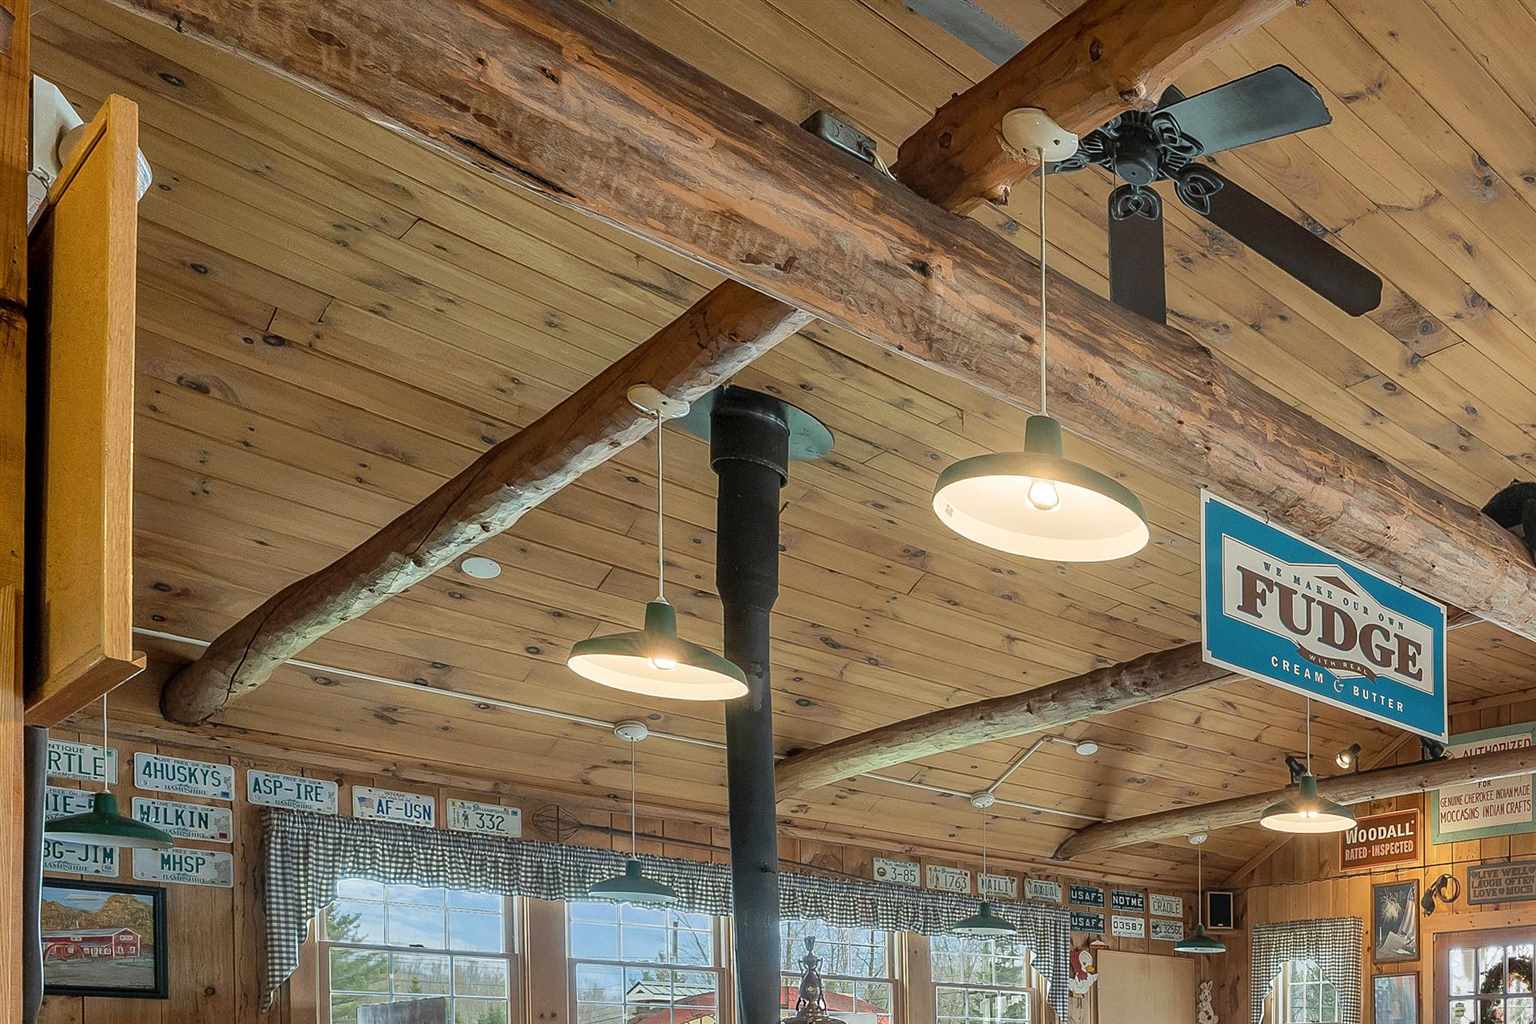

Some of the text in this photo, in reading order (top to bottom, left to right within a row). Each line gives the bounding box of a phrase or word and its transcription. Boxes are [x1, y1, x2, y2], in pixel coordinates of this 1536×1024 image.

[1263, 561, 1404, 631] WE MAKE OUR OWN
[1236, 565, 1423, 682] FUDGE
[1308, 654, 1368, 676] WITH REAL
[1271, 655, 1324, 684] CREAM
[1352, 685, 1405, 713] BUTTER
[142, 760, 222, 787] 4HUSKYS
[253, 777, 324, 803] ASP-IRE
[1440, 794, 1463, 808] GENUINE
[1464, 788, 1494, 805] CHEROKEE
[139, 804, 209, 830] WILKIN
[376, 799, 432, 821] AF-USN
[1440, 799, 1531, 824] MOCCASINS INDIAN CRAFTS
[475, 812, 505, 831] 332
[1345, 822, 1414, 845] WOODALL
[160, 853, 206, 874] MHSP
[890, 867, 916, 883] 3-85
[944, 875, 967, 890] 1763
[1113, 920, 1142, 931] 03587
